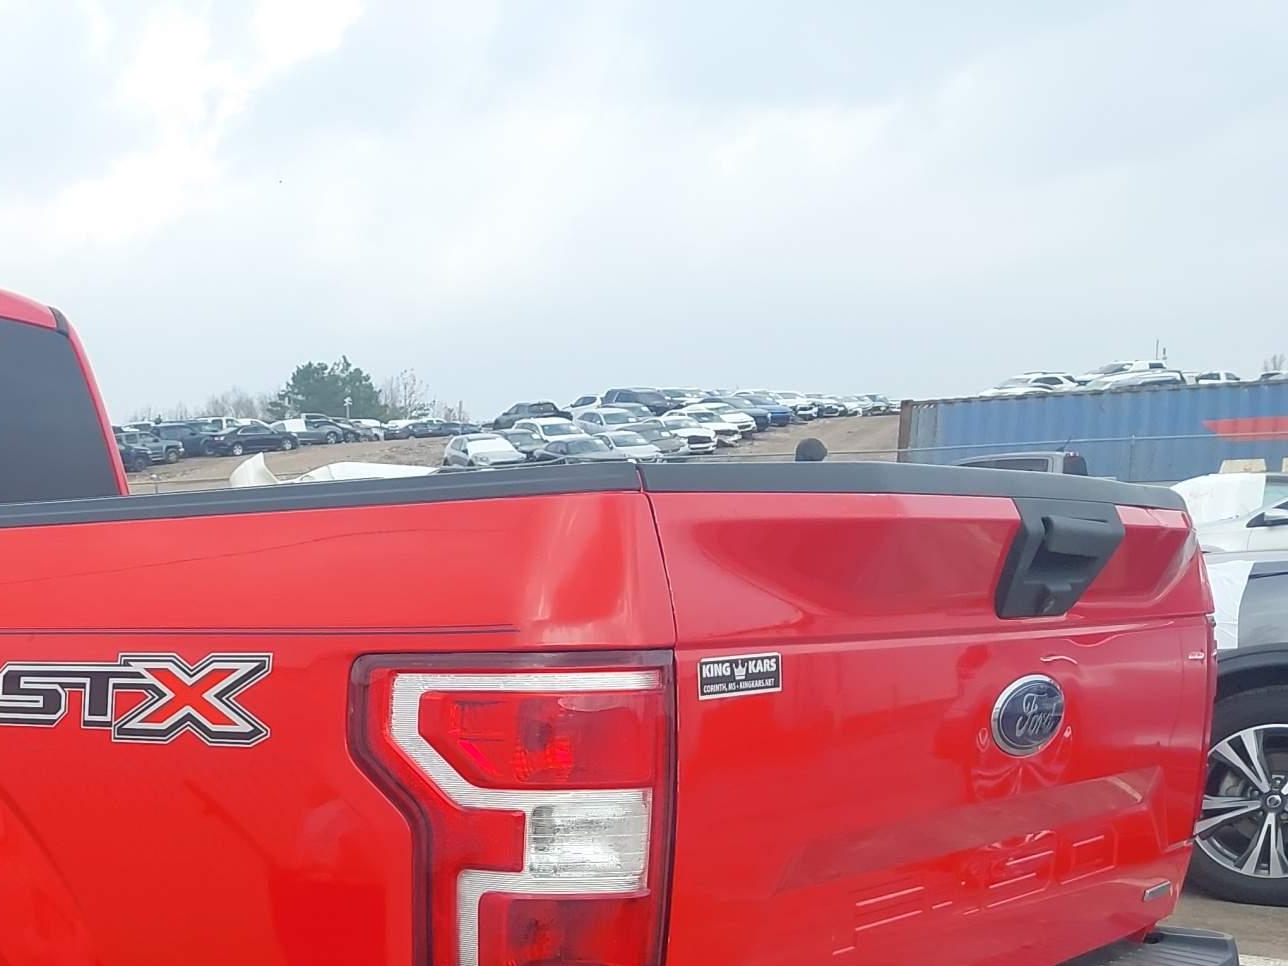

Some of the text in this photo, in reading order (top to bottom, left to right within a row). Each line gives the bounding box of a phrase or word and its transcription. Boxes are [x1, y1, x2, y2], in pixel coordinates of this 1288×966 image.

[702, 658, 777, 678] KING KARS
[1016, 693, 1058, 737] Ford
